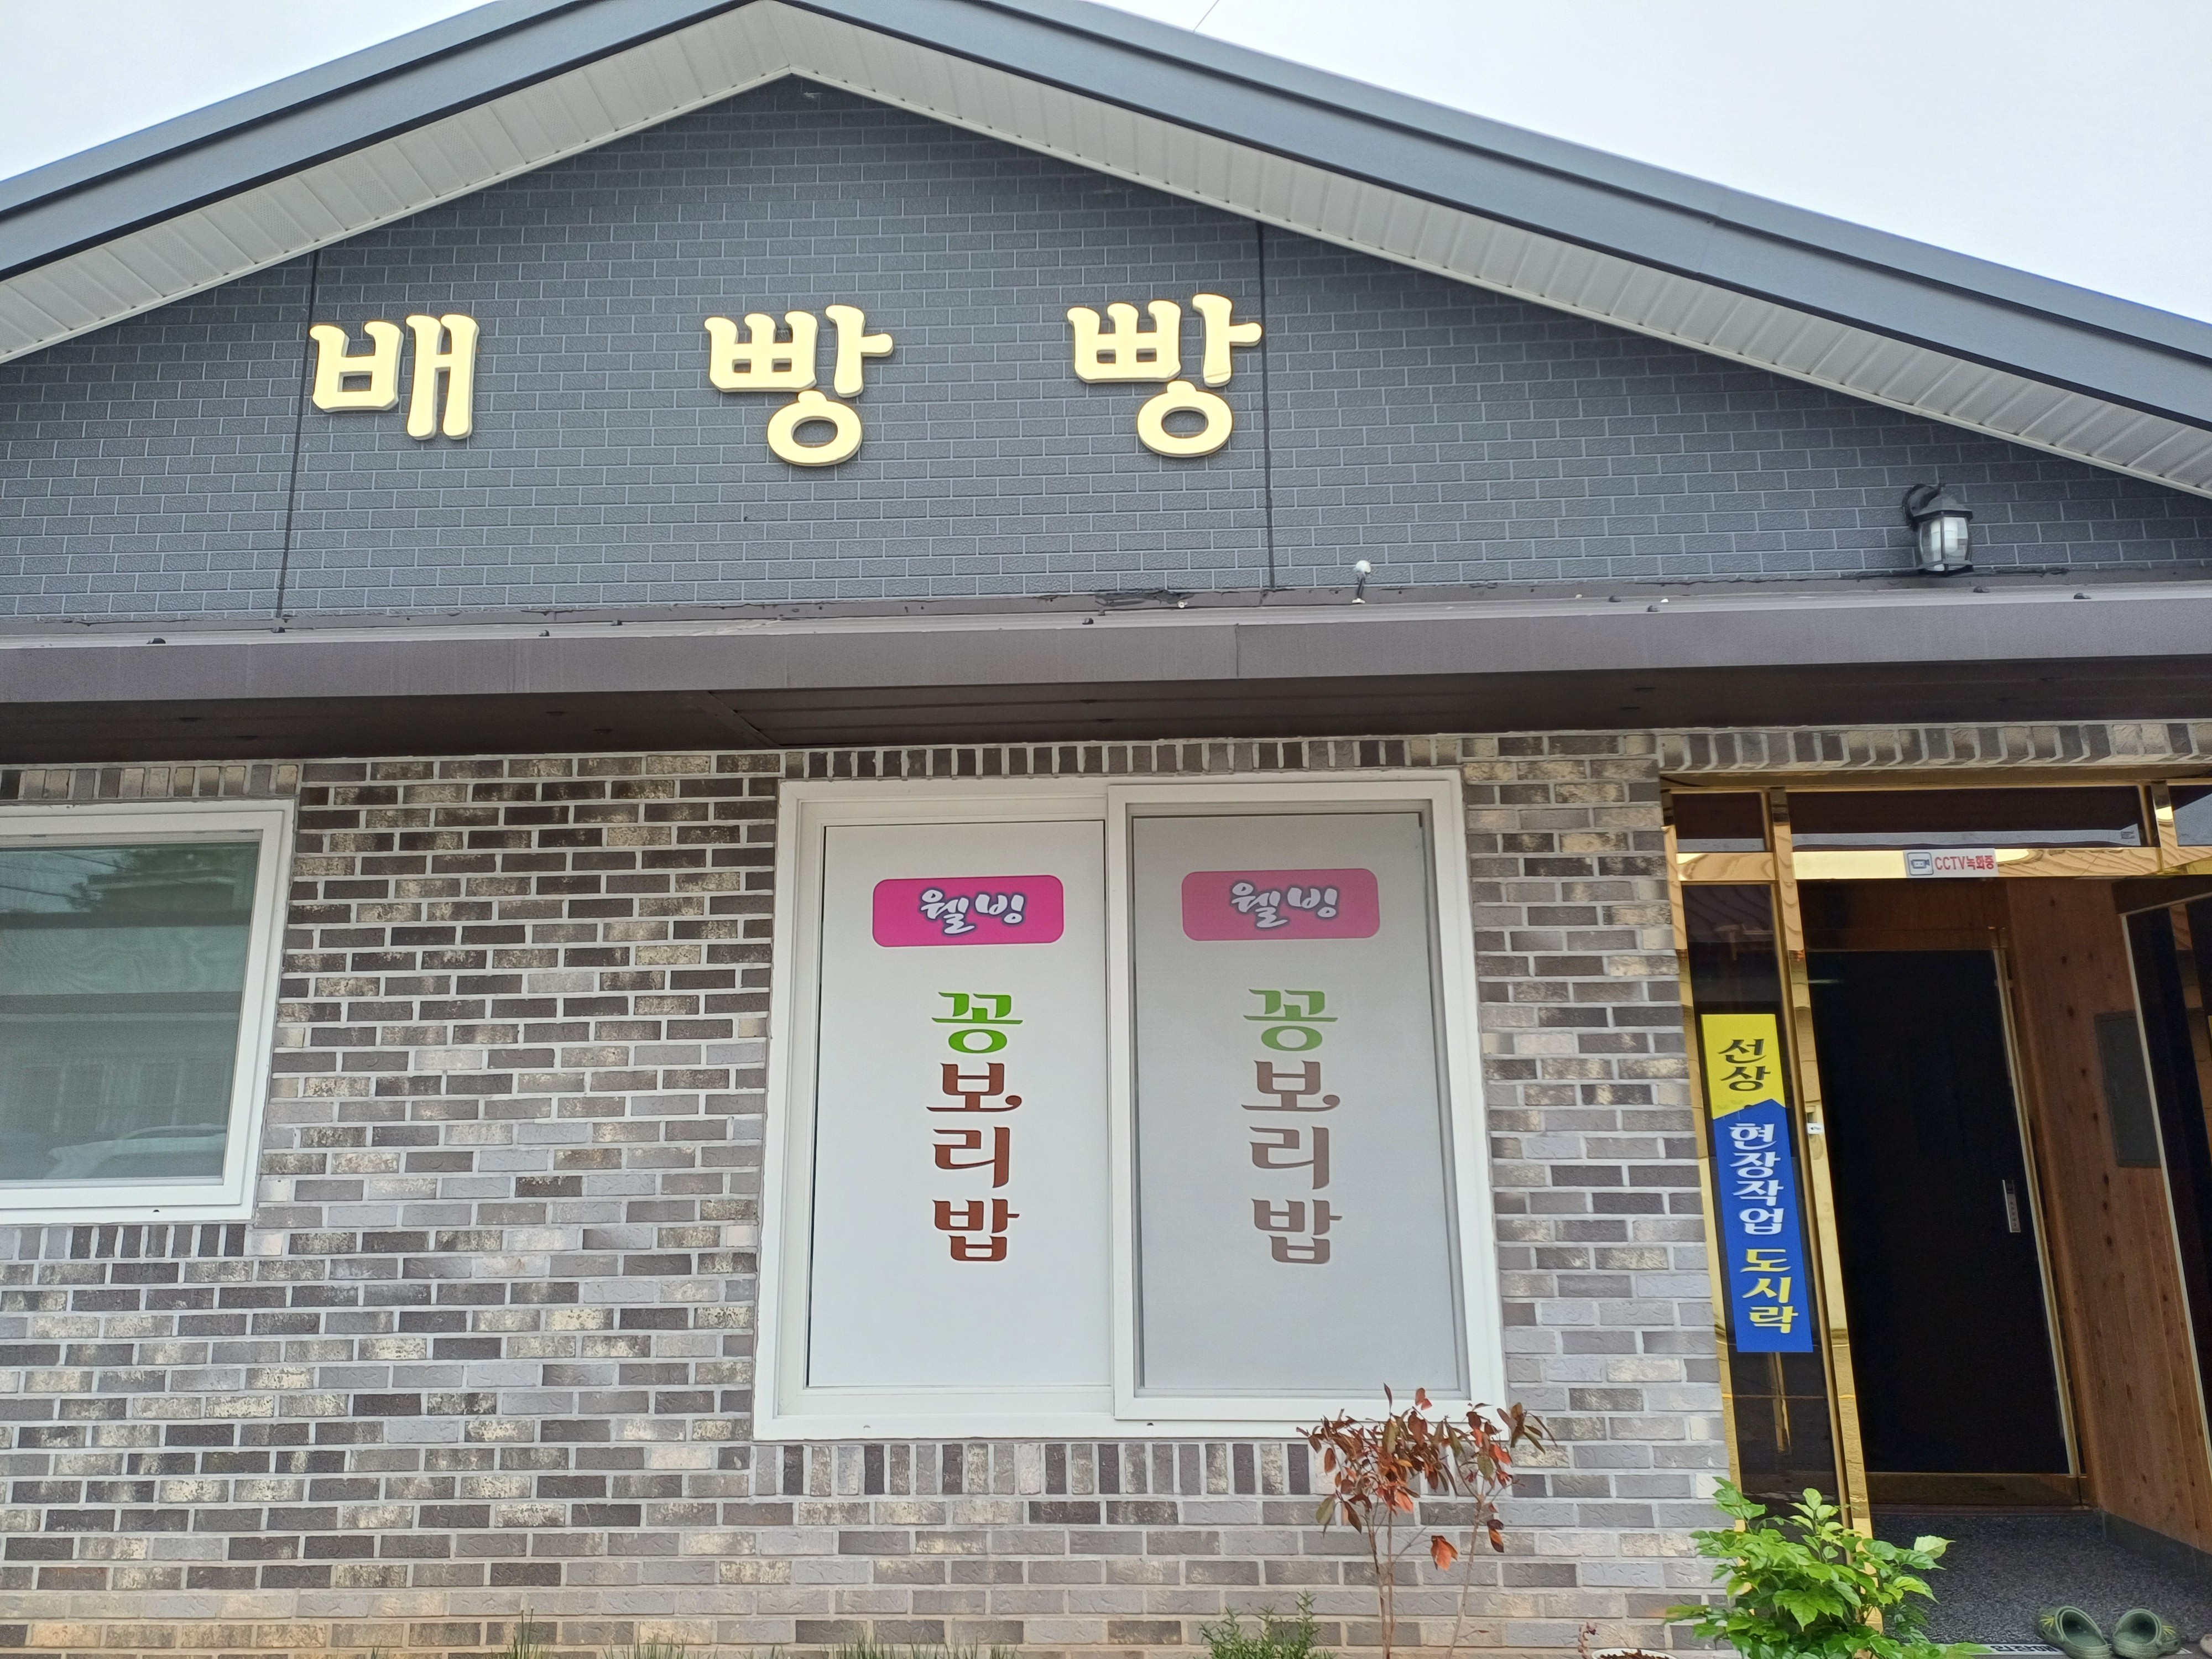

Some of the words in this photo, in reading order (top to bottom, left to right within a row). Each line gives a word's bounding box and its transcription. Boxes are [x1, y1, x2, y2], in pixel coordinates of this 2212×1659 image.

[310, 314, 480, 440] 배
[703, 304, 895, 466] 빵
[1067, 294, 1263, 458] 빵
[1230, 881, 1337, 928] 웰빙
[1934, 855, 1995, 870] CCTV녹화중
[920, 889, 1024, 935] 웰빙
[1718, 1038, 1771, 1092] 선상
[927, 992, 1023, 1262] 꽁보리밥
[1241, 989, 1343, 1265] 꽁보리밥
[1728, 1123, 1785, 1235] 현장작업
[1740, 1248, 1799, 1334] 도시락
